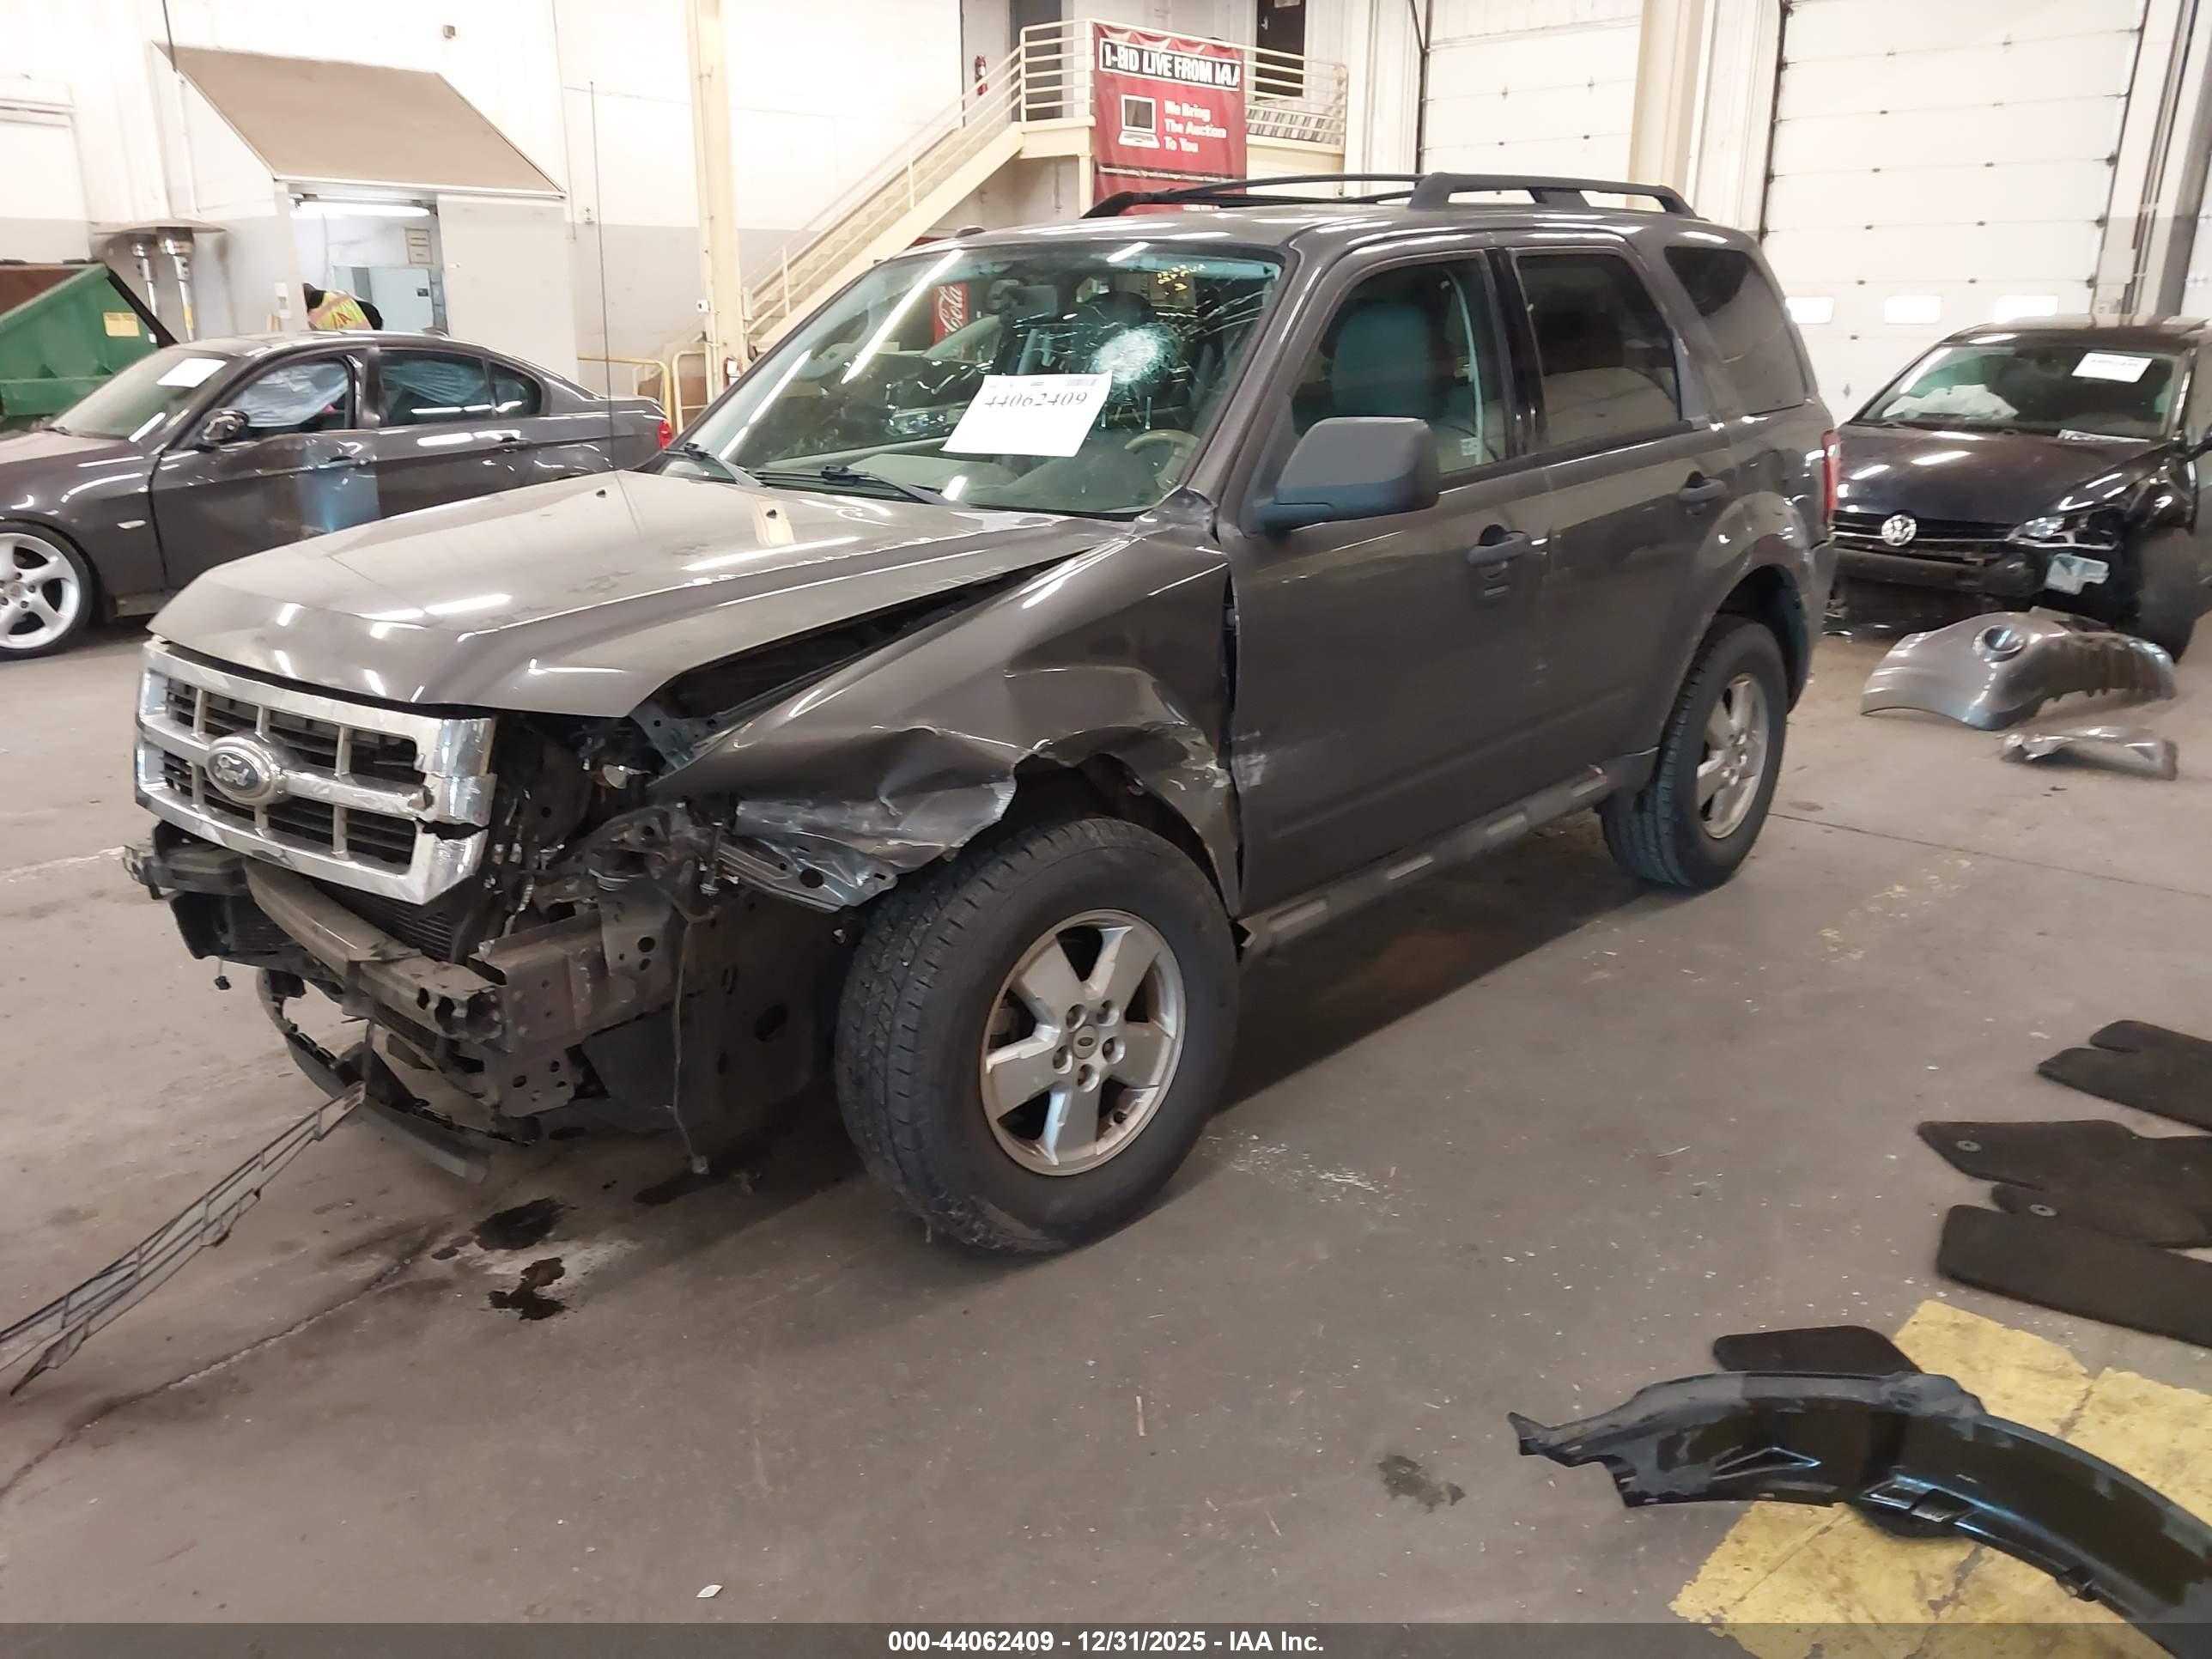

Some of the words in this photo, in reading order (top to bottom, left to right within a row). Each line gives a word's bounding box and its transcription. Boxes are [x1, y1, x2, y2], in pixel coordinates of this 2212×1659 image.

[1142, 52, 1173, 76] LIVE
[1174, 57, 1212, 83] FROM
[1164, 100, 1182, 116] We
[1182, 102, 1211, 122] Bring
[1164, 118, 1184, 133] The
[1185, 121, 1227, 138] Auction
[1164, 136, 1177, 151] To
[1179, 137, 1199, 153] You
[938, 285, 963, 332] Cola
[984, 392, 1088, 408] 44062409
